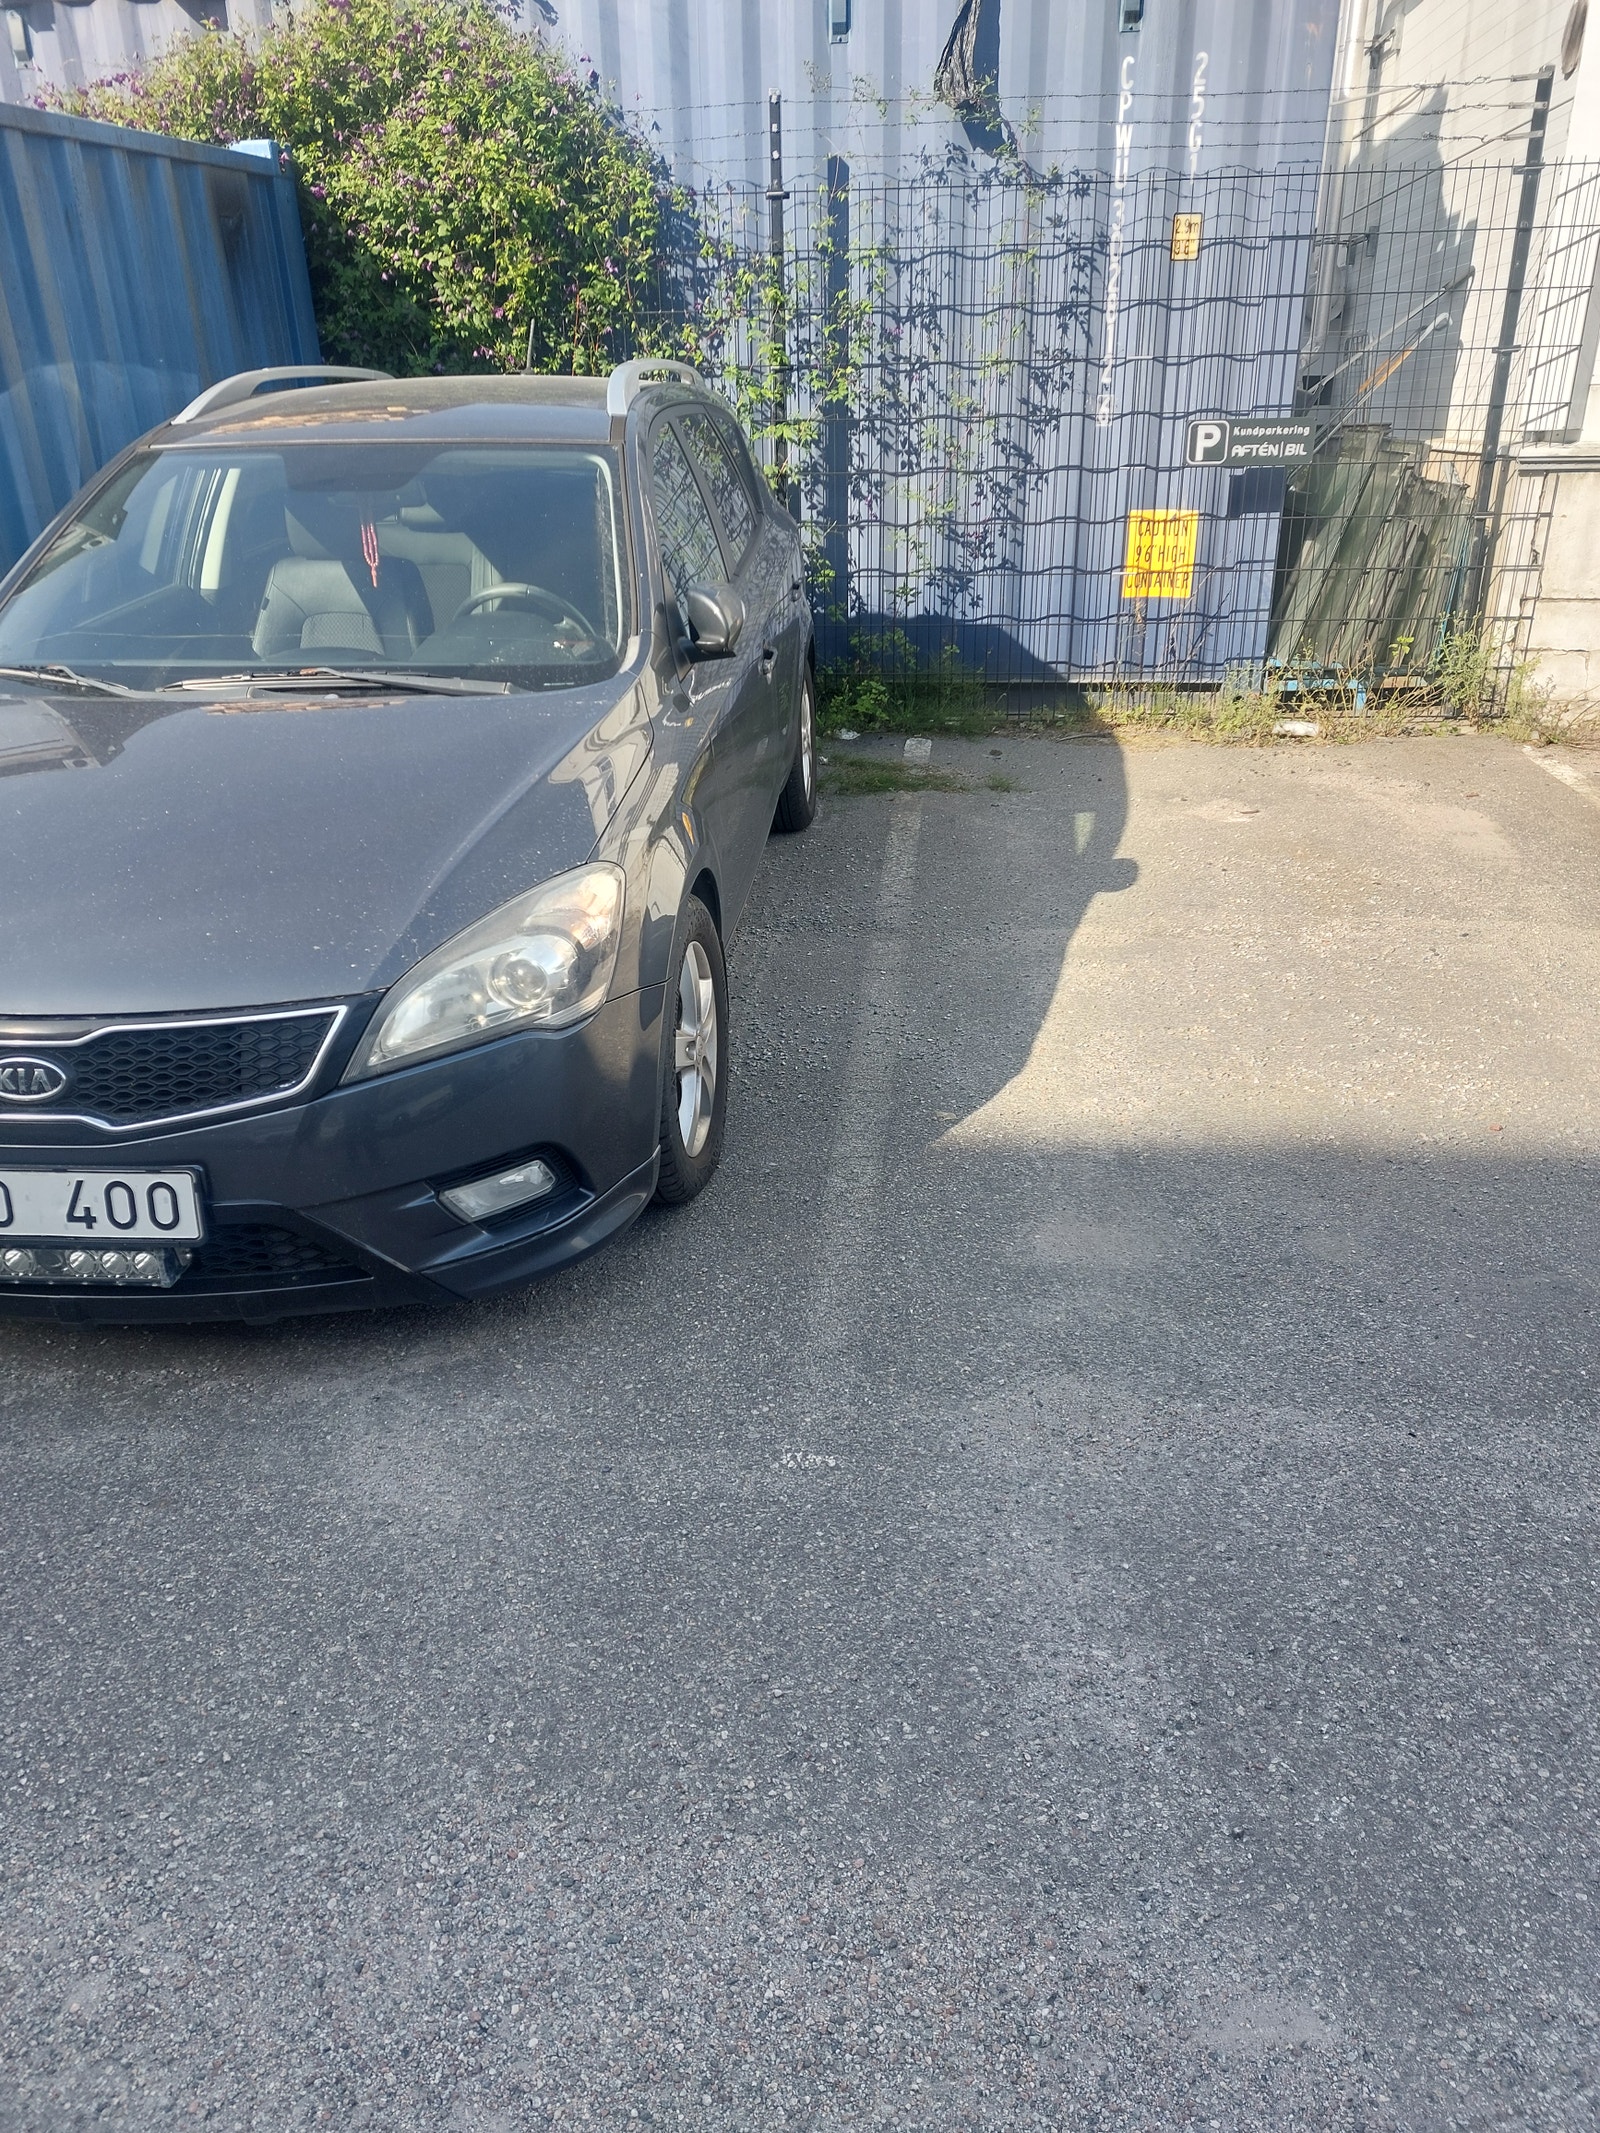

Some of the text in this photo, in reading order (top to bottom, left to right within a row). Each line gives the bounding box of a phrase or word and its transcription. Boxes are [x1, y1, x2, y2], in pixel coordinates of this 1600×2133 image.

[1115, 56, 1135, 190] CPWU
[1189, 51, 1209, 185] 25G1
[1195, 424, 1310, 461] P Kundparkering
[1138, 520, 1189, 537] CAUTION
[1158, 545, 1187, 563] HIGH
[1126, 572, 1190, 589] CONTAINER
[0, 1068, 51, 1093] KIA
[66, 1180, 180, 1231] 400
